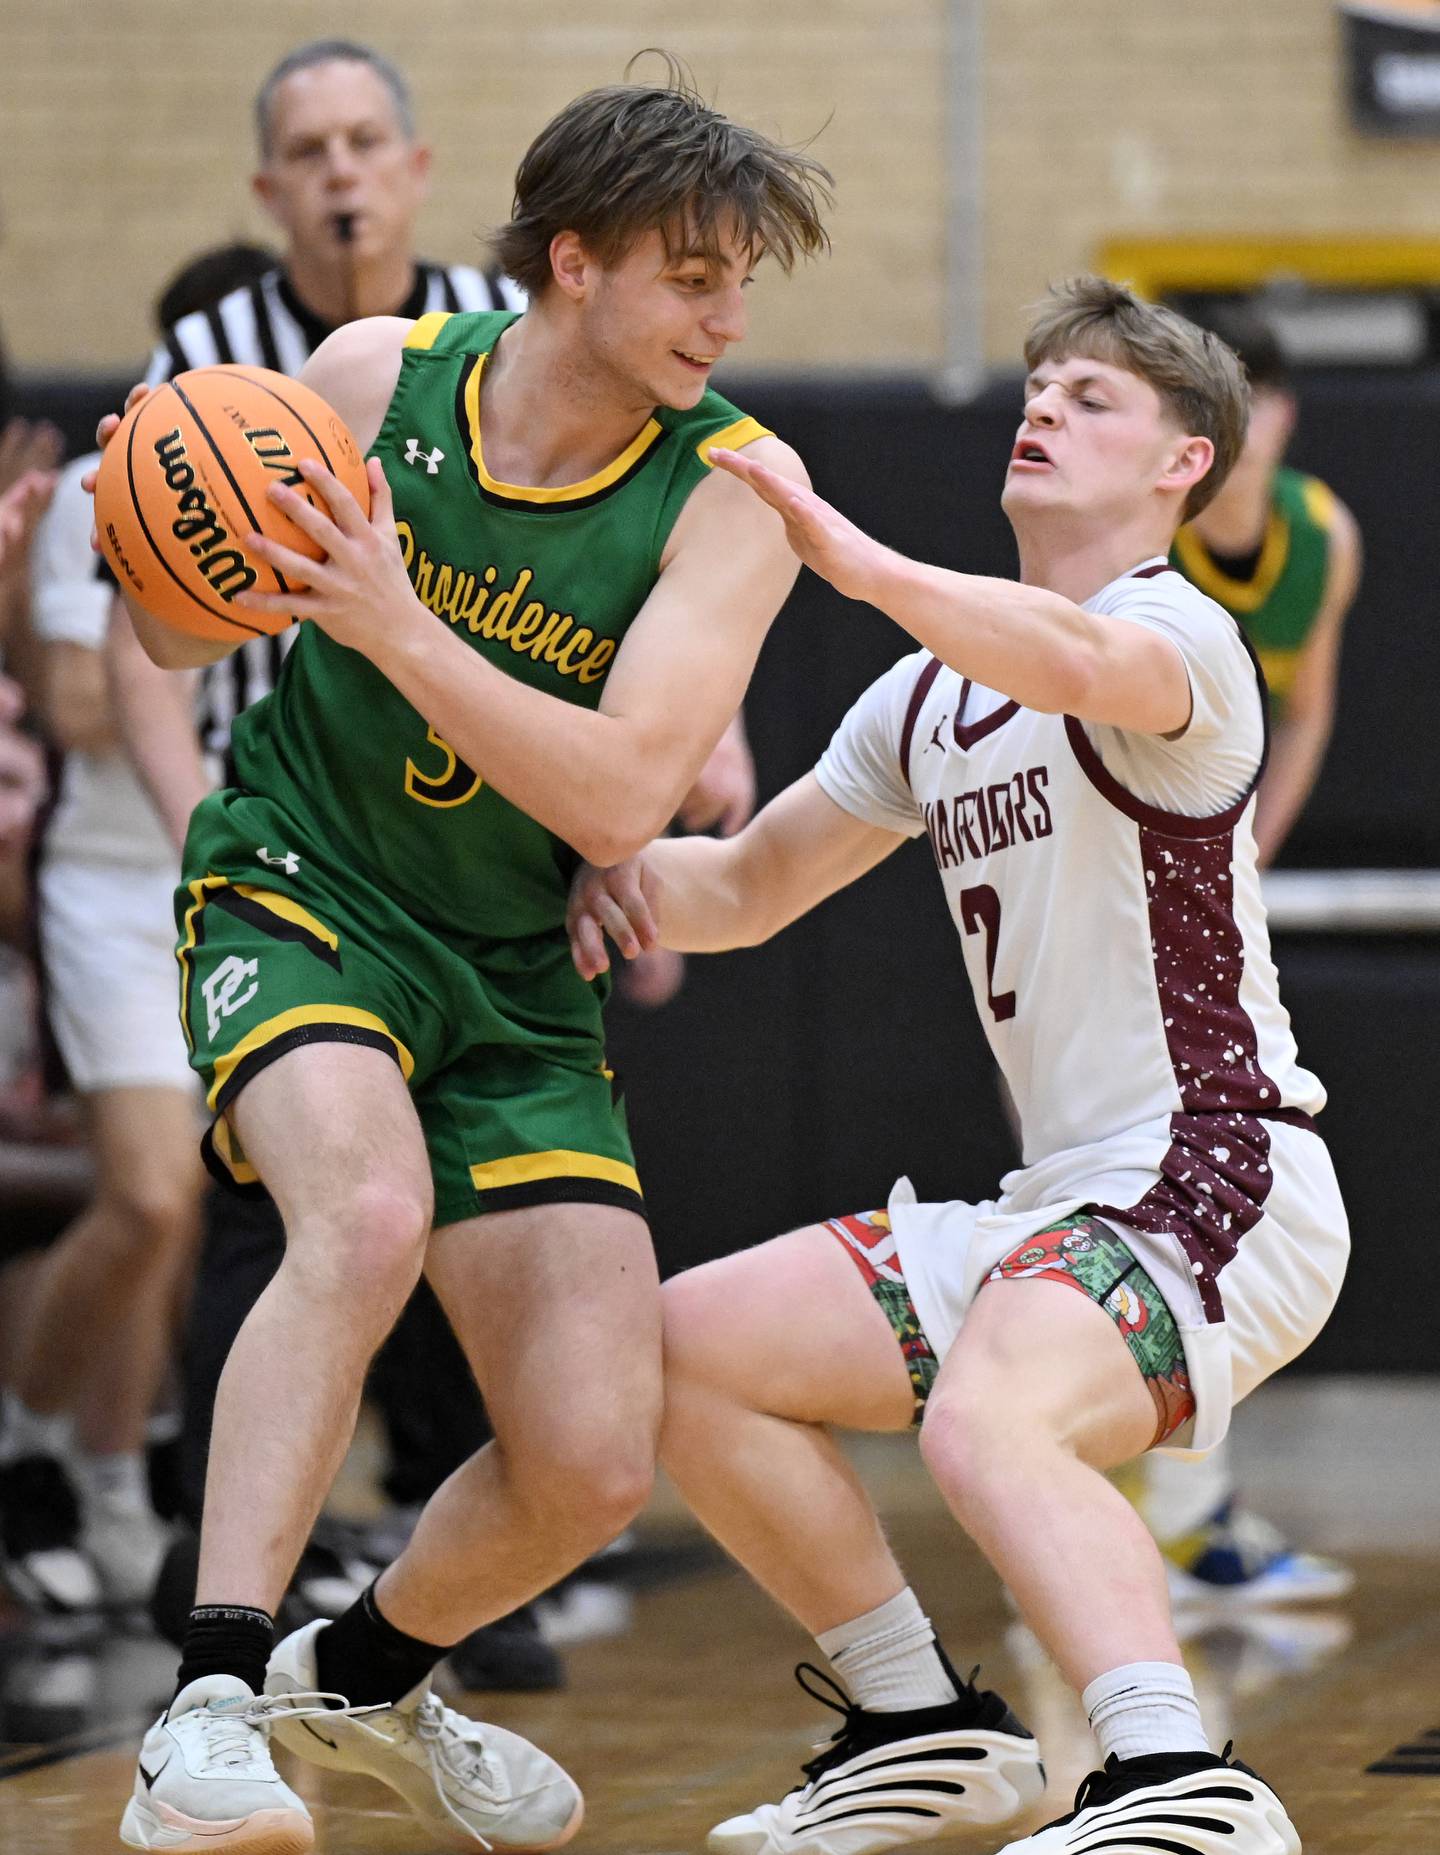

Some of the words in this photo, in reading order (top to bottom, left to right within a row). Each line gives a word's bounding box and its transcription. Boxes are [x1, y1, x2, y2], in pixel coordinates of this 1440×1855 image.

[154, 425, 257, 604] Wilson
[202, 955, 258, 1043] PC
[960, 884, 1016, 1022] 2
